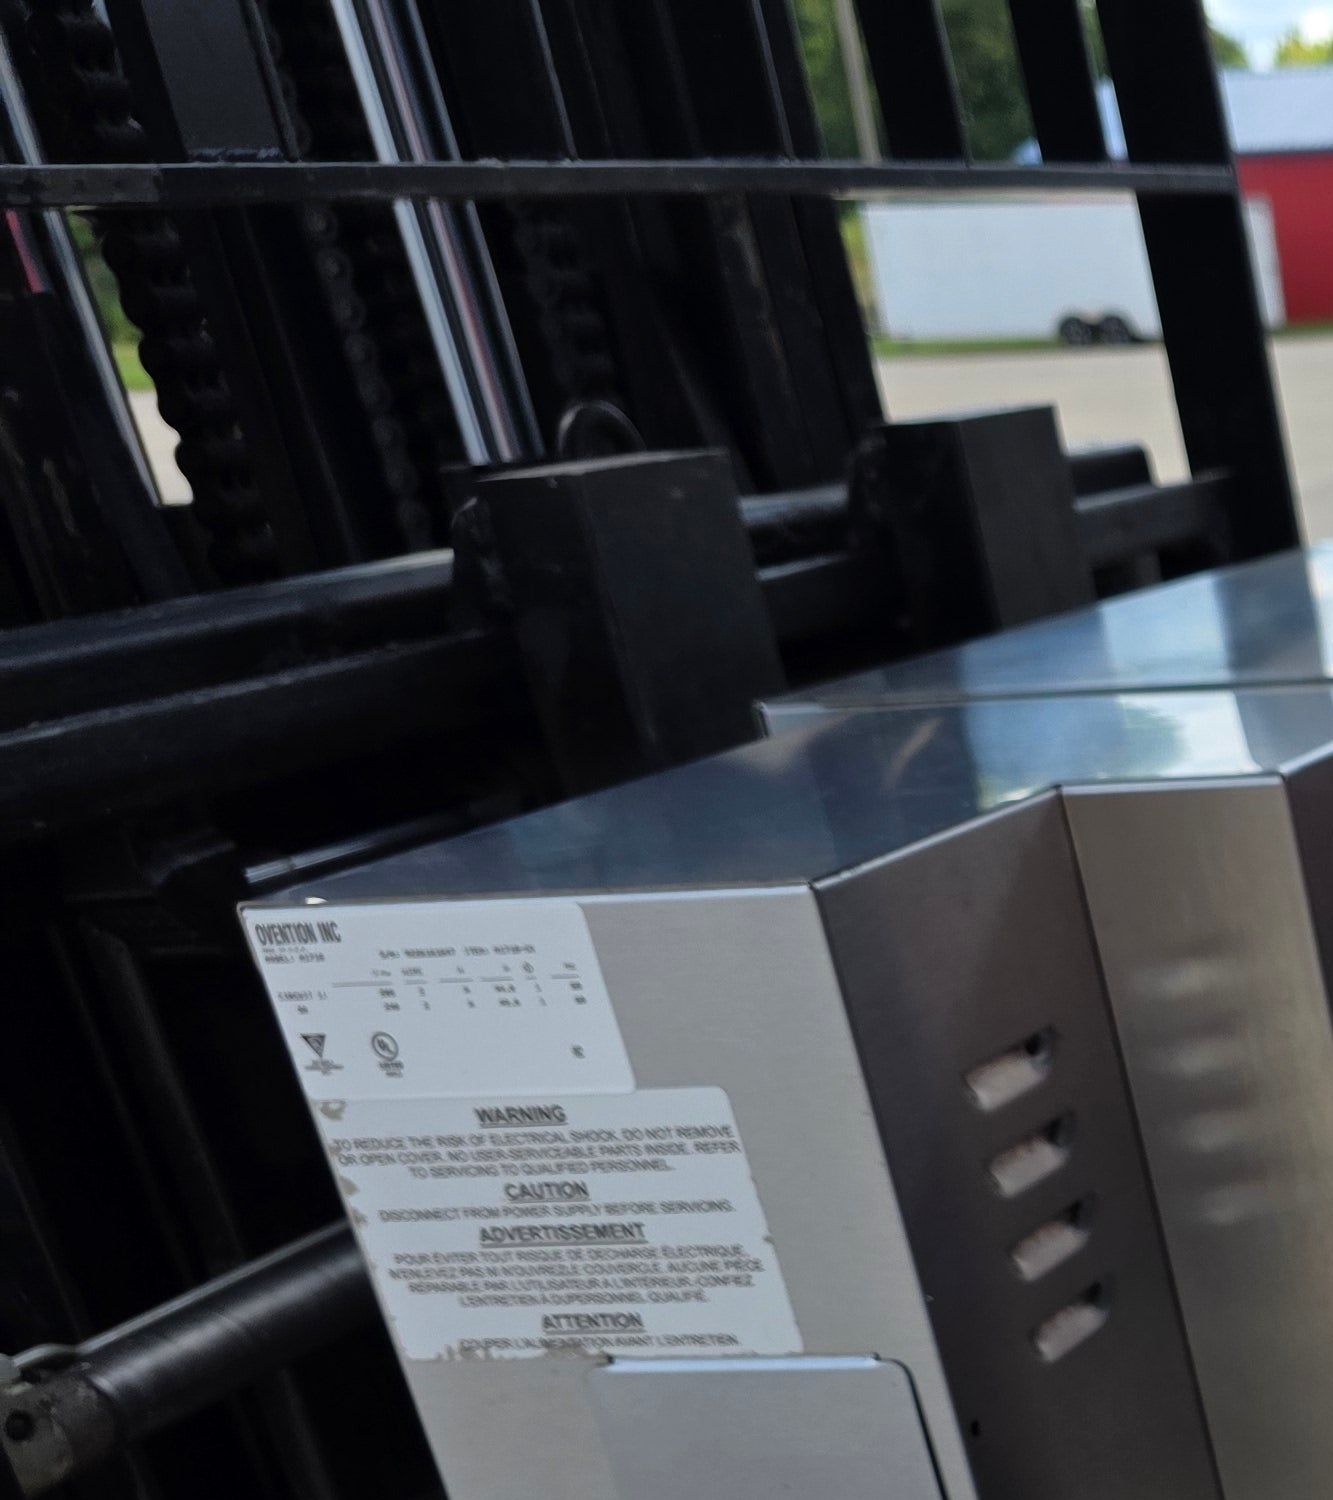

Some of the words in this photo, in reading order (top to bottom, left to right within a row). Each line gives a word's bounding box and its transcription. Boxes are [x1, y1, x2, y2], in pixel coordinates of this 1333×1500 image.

[255, 922, 317, 945] OVENTION
[318, 921, 342, 943] INC
[477, 1105, 565, 1124] WARNING
[353, 1136, 404, 1150] REDUCE
[408, 1135, 432, 1148] THE
[436, 1134, 466, 1147] RISK
[489, 1131, 565, 1145] ELECTRICAL
[646, 1128, 672, 1141] NOT
[677, 1126, 734, 1140] REMOVE
[359, 1151, 395, 1164] OPEN
[430, 1163, 498, 1177] SERVICING
[504, 1181, 588, 1200] CAUTION
[379, 1208, 460, 1222] DISCONNECT
[478, 1222, 645, 1242] ADVERTISSEMENT
[541, 1312, 640, 1330] ATTENTION
